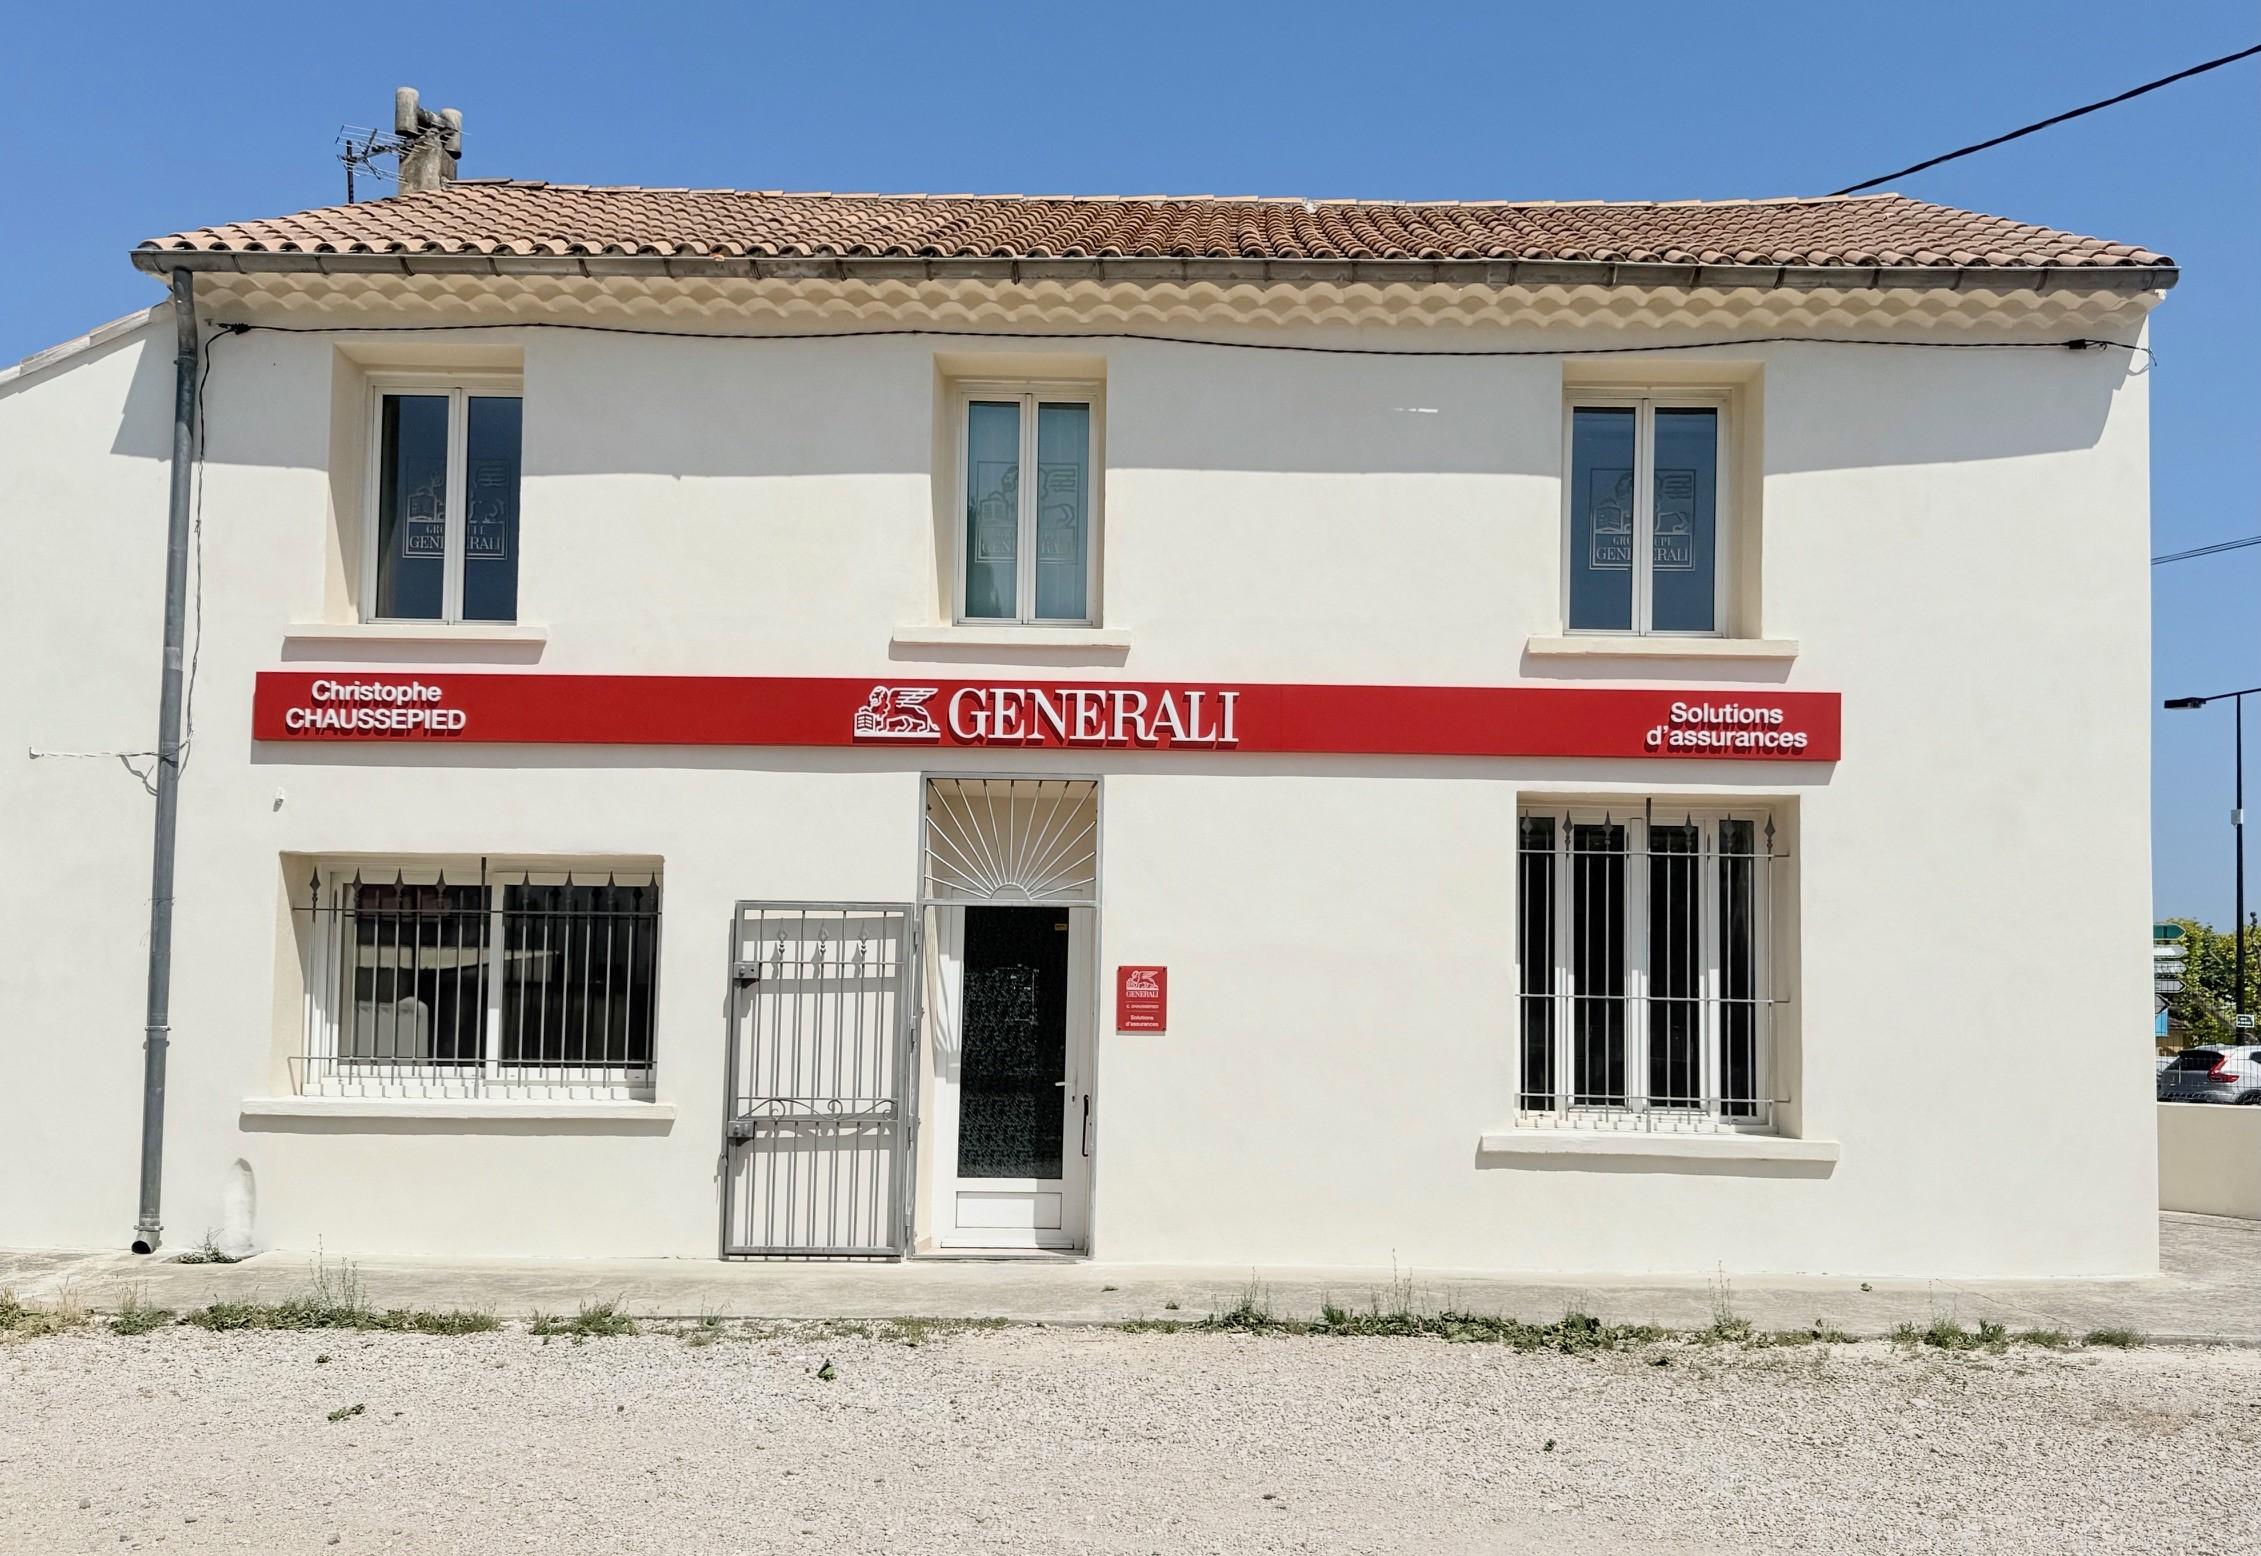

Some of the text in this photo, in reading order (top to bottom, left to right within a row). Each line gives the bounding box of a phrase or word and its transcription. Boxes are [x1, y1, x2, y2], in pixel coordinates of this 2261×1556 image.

[311, 680, 442, 704] Christophe
[285, 707, 467, 730] CHAUSSEPIED
[947, 686, 1240, 742] GENERALI
[1670, 702, 1784, 724] Solutions
[1646, 725, 1808, 748] d'assurances
